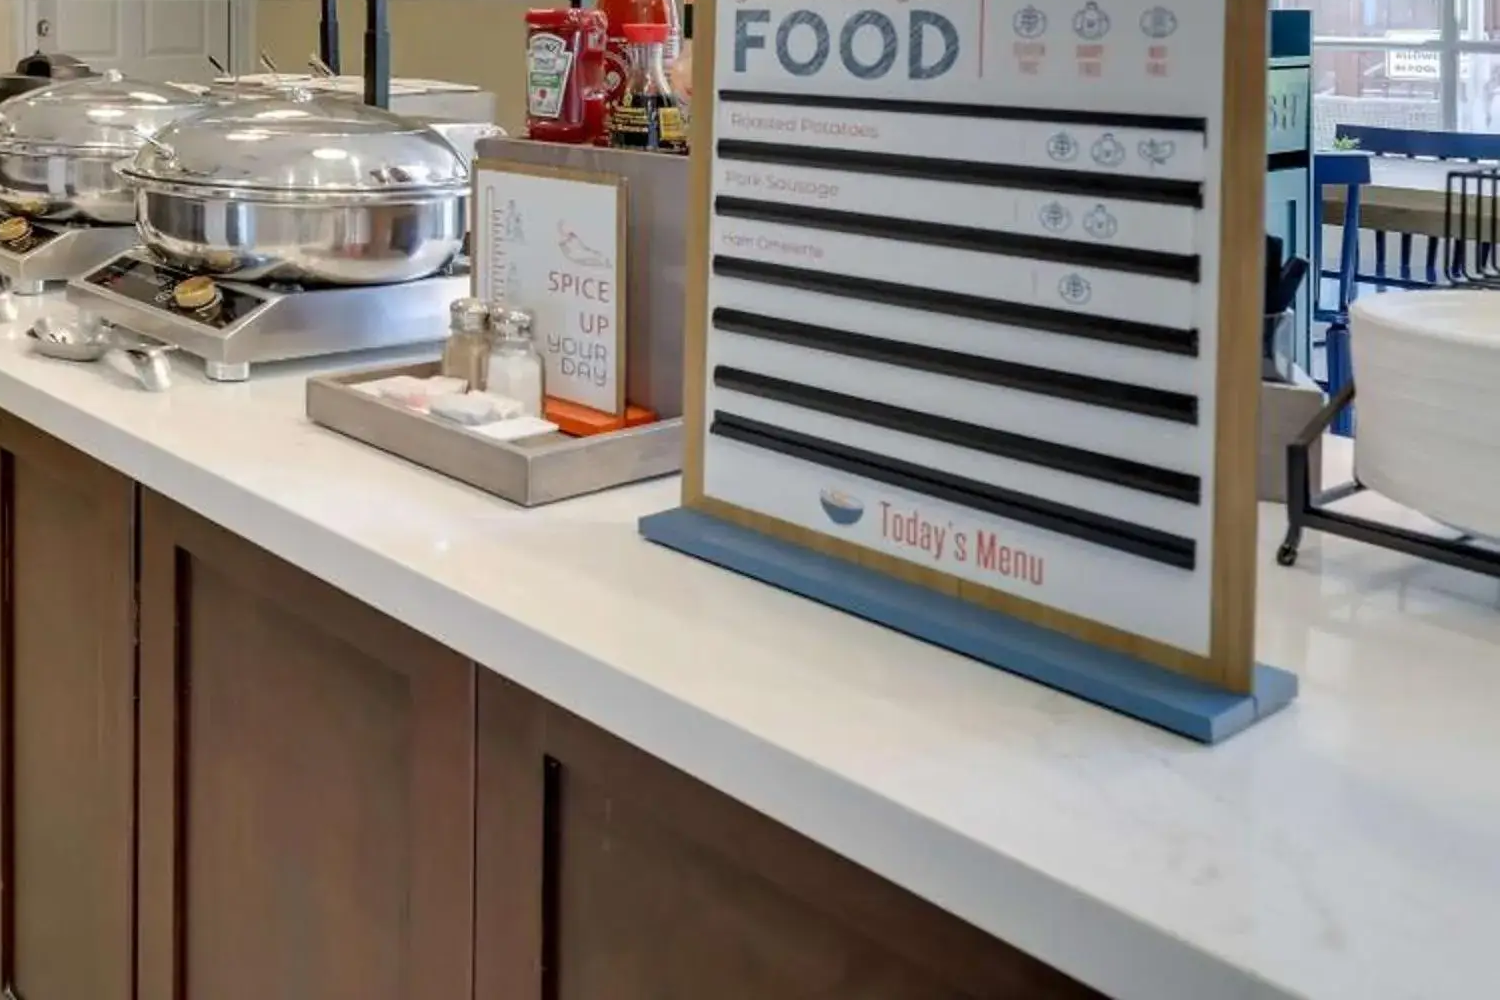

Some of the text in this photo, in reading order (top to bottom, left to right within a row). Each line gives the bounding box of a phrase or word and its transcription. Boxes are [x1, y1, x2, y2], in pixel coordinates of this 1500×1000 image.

[733, 8, 961, 81] FOOD
[547, 271, 611, 304] SPICE
[578, 311, 610, 336] UP
[547, 334, 607, 363] YOUR
[561, 357, 607, 388] DAY
[878, 500, 1045, 587] Today's Menu
